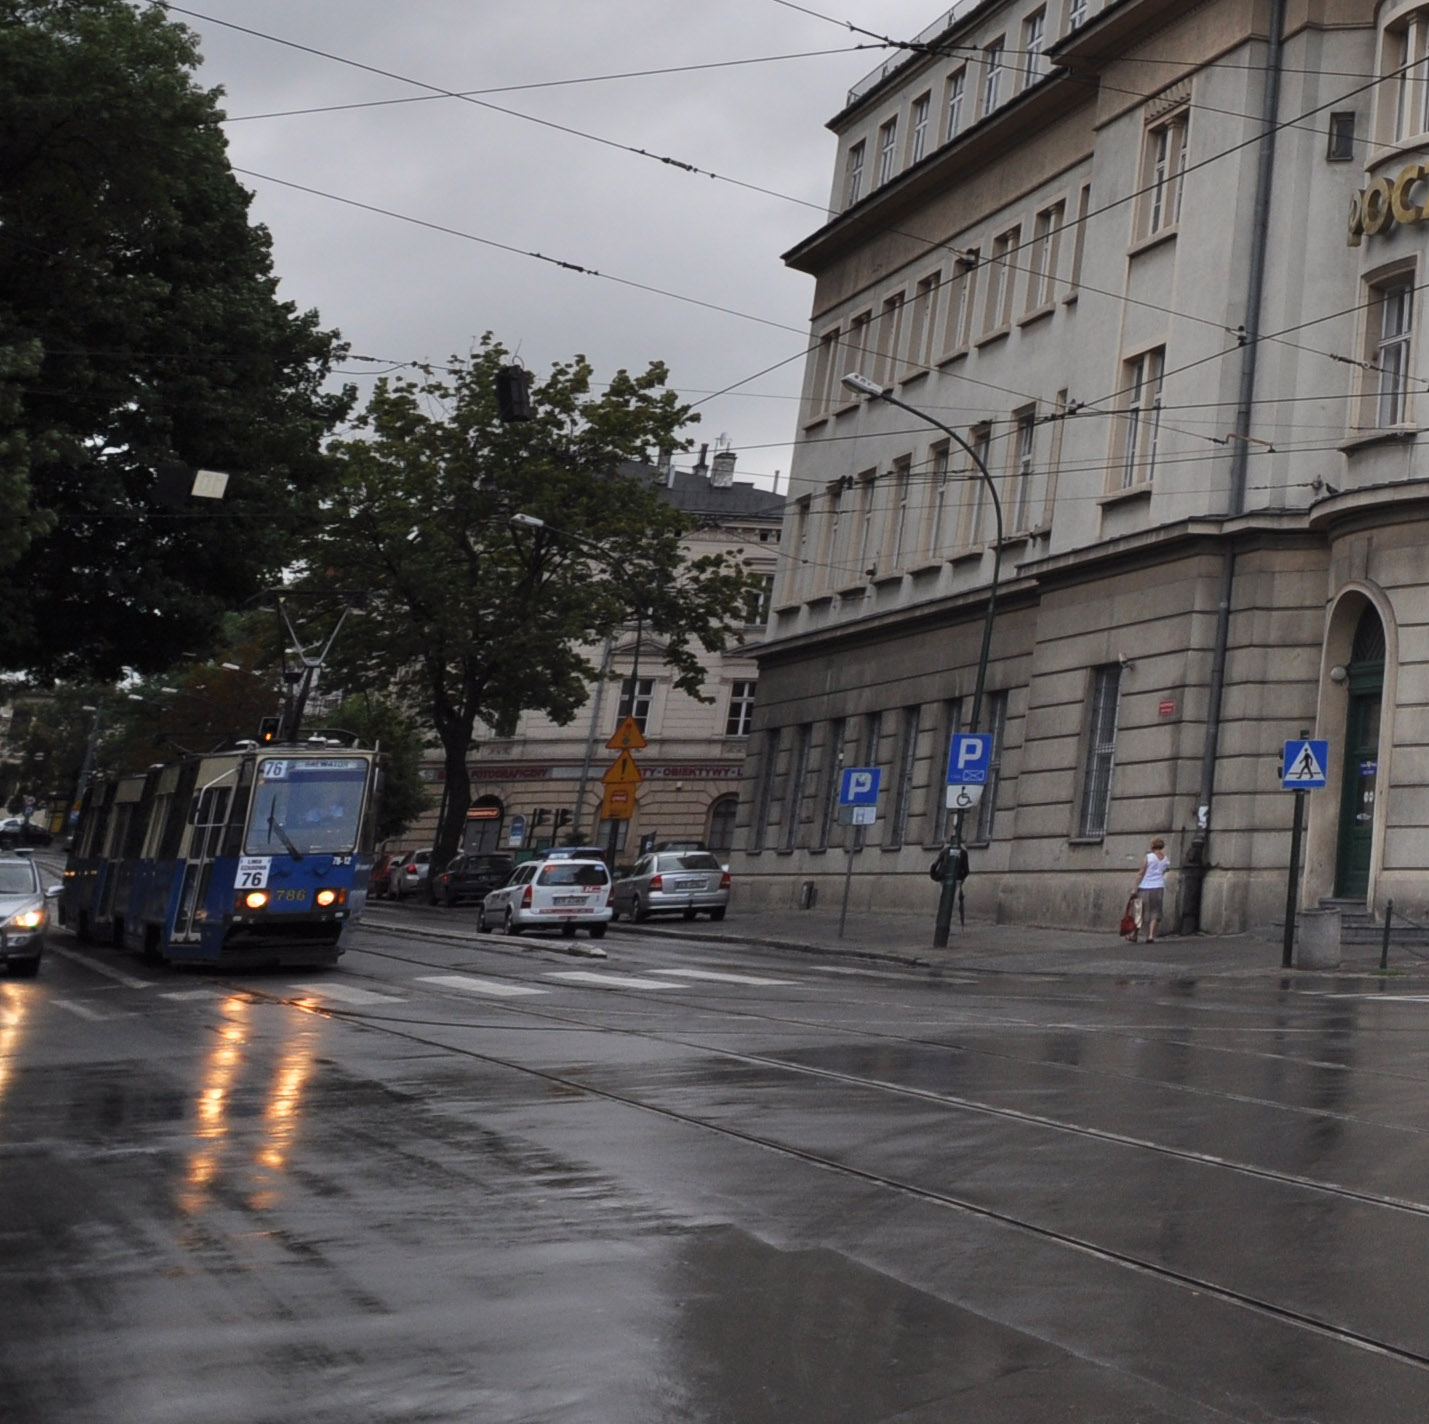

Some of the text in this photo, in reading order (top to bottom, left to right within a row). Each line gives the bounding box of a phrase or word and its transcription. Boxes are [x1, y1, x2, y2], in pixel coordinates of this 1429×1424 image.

[958, 738, 983, 769] P
[265, 761, 284, 776] 76
[848, 772, 873, 801] P
[241, 872, 263, 887] 76
[276, 889, 307, 901] 786
